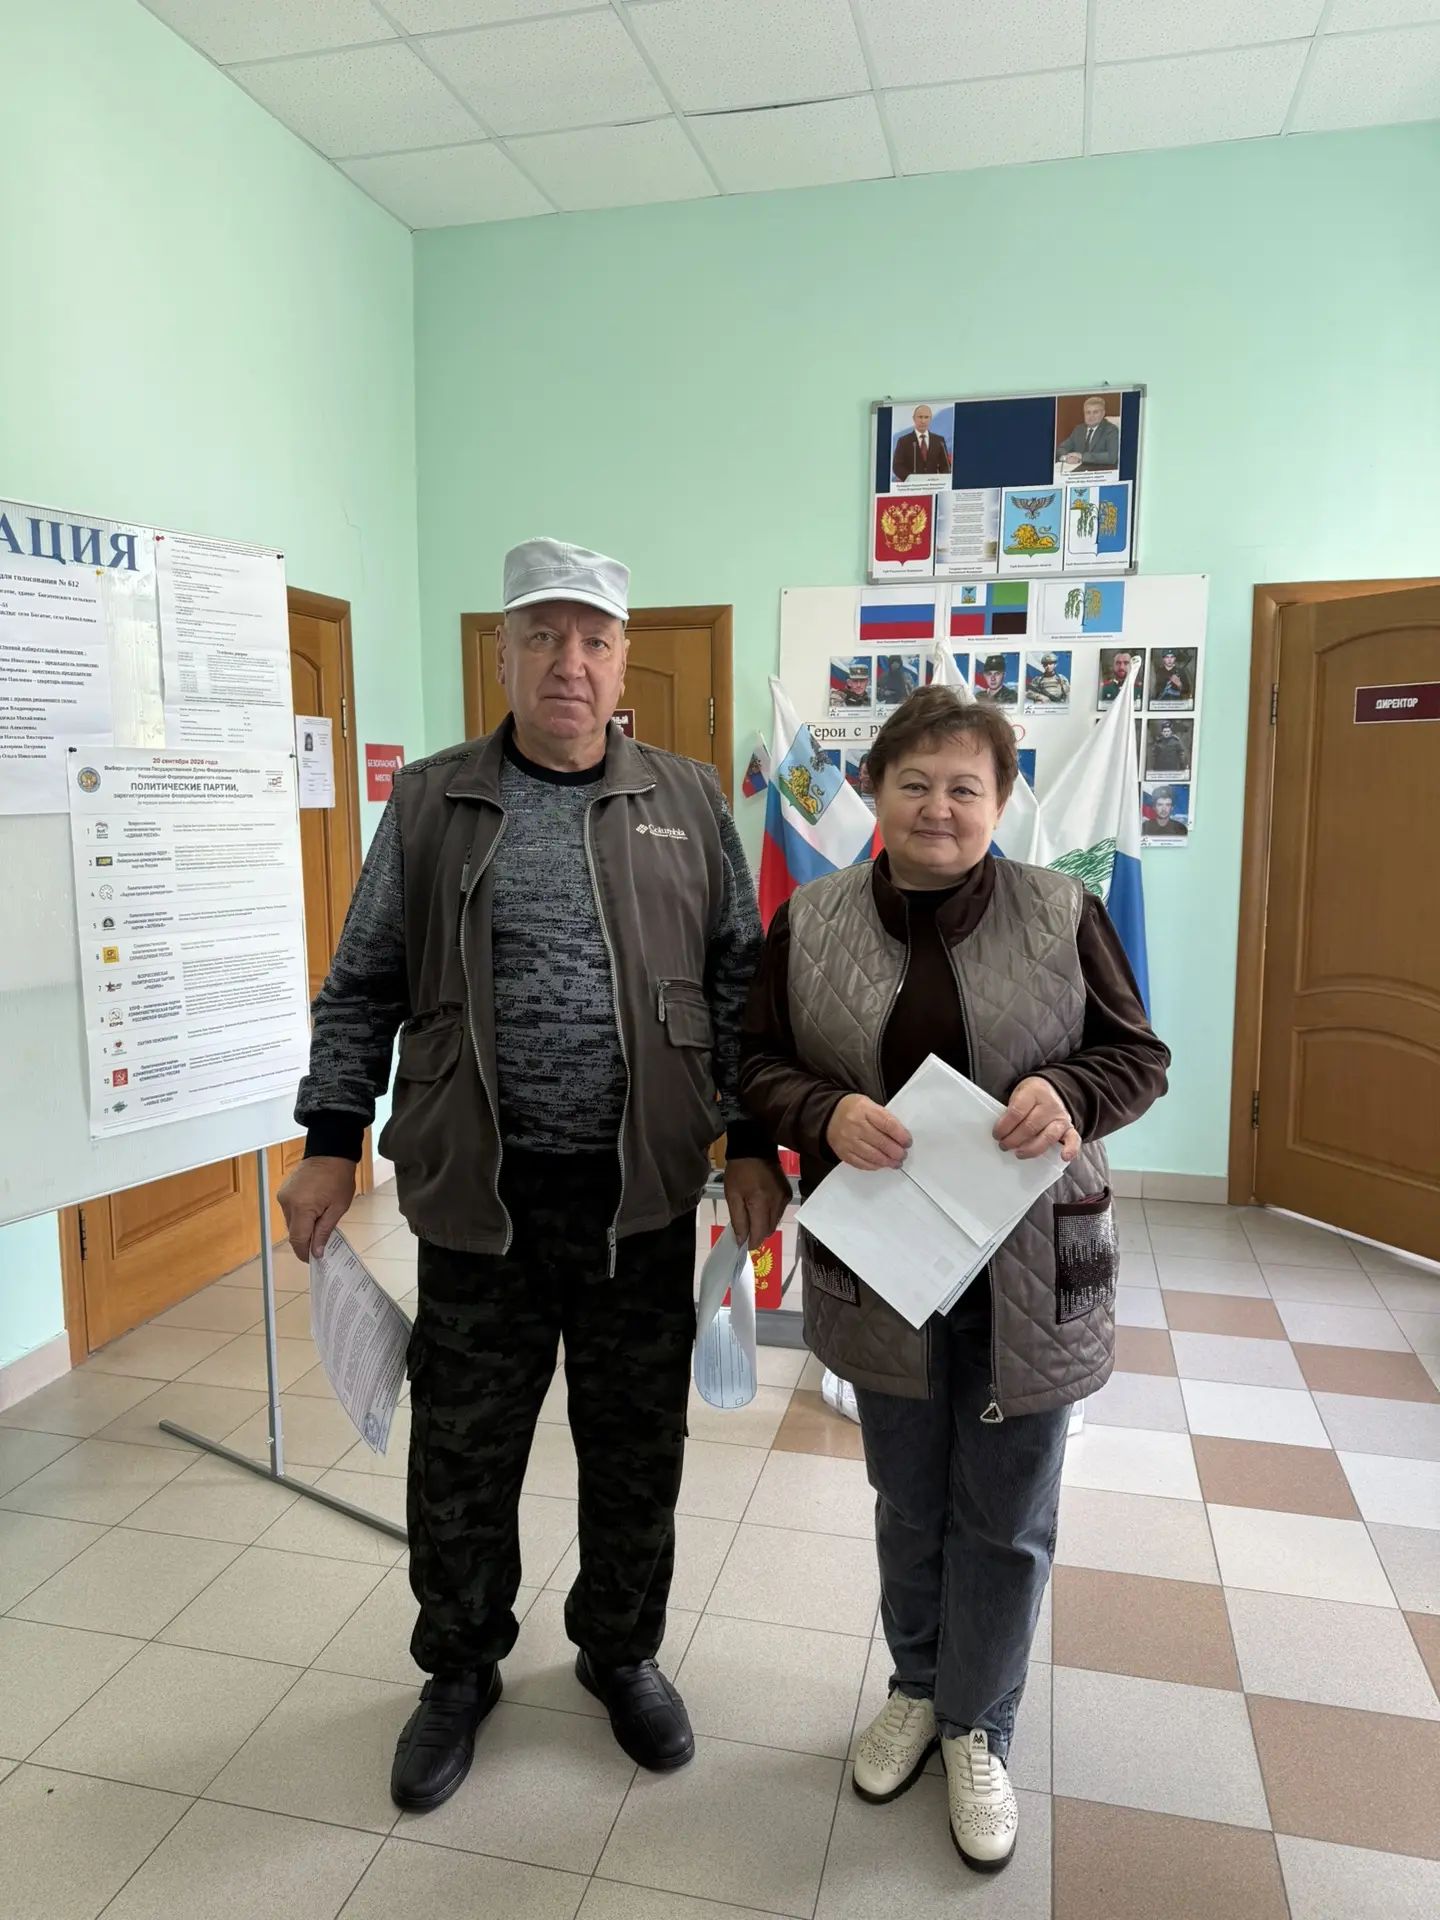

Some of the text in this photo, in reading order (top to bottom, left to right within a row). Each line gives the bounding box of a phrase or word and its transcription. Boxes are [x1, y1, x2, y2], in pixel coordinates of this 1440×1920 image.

[0, 513, 140, 571] АЦИЯ
[68, 580, 79, 588] 612
[1375, 698, 1418, 709] ДИРЕКТОР
[807, 724, 846, 740] Герои
[854, 727, 862, 736] с
[131, 782, 238, 792] ПОЛИТИЧЕСКИЕ ПАРТИИ,
